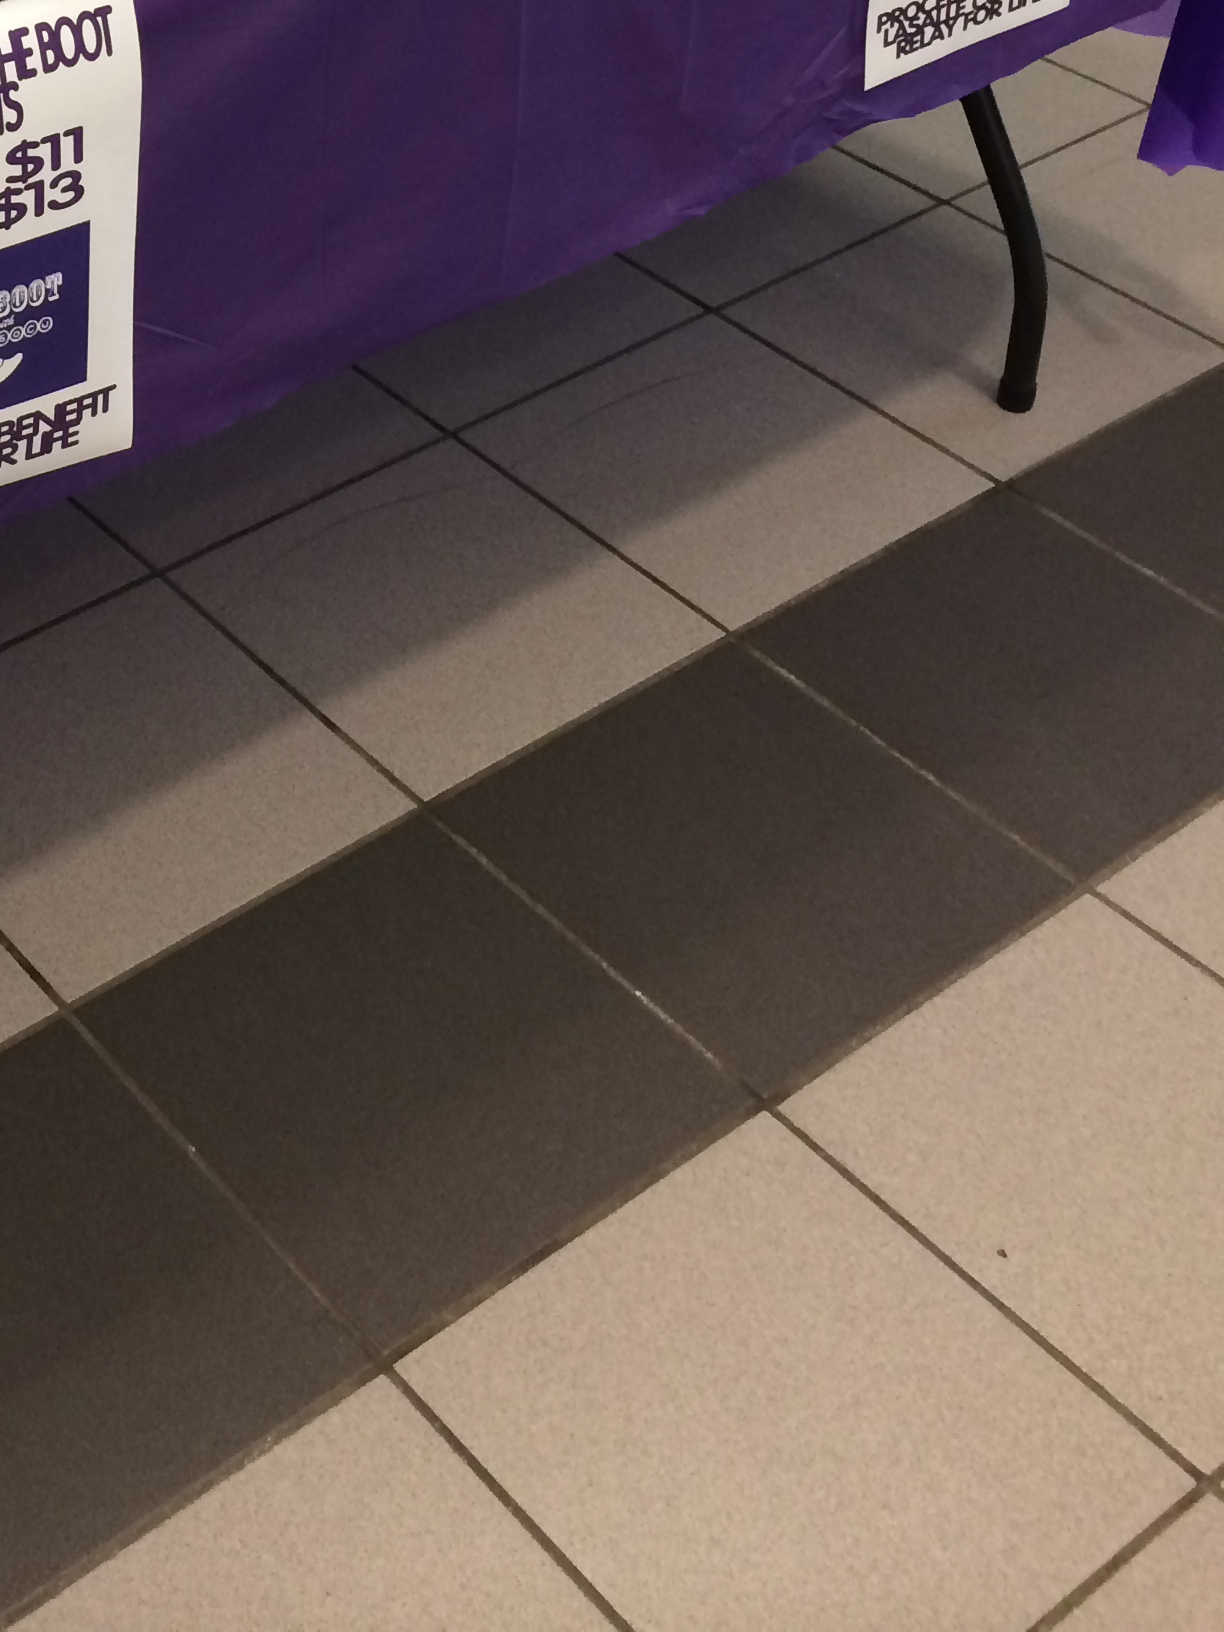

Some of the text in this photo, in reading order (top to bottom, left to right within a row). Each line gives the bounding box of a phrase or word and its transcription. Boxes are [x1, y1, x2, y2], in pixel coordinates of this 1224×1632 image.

[34, 4, 113, 75] BOOT
[895, 18, 959, 60] RELAY
[962, 1, 1003, 32] FOR
[5, 125, 84, 184] $11
[25, 428, 80, 461] LIFE
